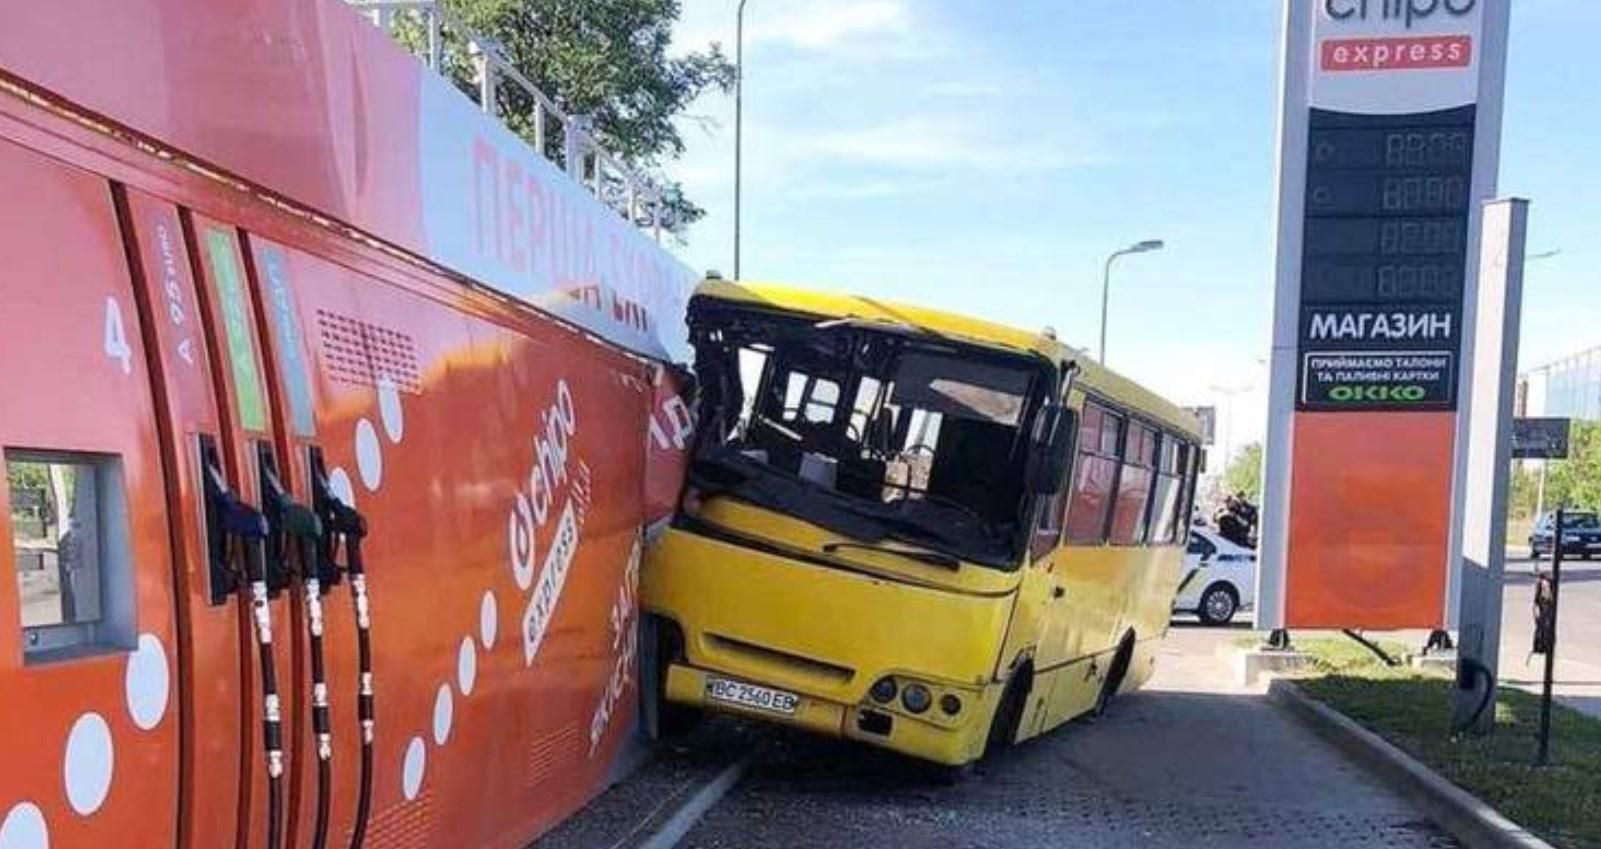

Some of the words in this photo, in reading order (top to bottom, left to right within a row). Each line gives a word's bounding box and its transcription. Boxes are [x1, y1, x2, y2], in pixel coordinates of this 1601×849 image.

[1333, 42, 1462, 67] express
[104, 295, 132, 375] 4
[1308, 312, 1452, 340] МАГАЗИН
[1311, 356, 1394, 369] ПРИЙМАЄМО
[1396, 356, 1447, 368] ТАЛОНИ
[1317, 371, 1333, 382] ТА
[1335, 370, 1392, 382] ПАЛИВНІ
[1393, 370, 1440, 381] КАРТКИ
[530, 378, 576, 527] chipo
[526, 515, 576, 644] express
[715, 681, 737, 697] BC
